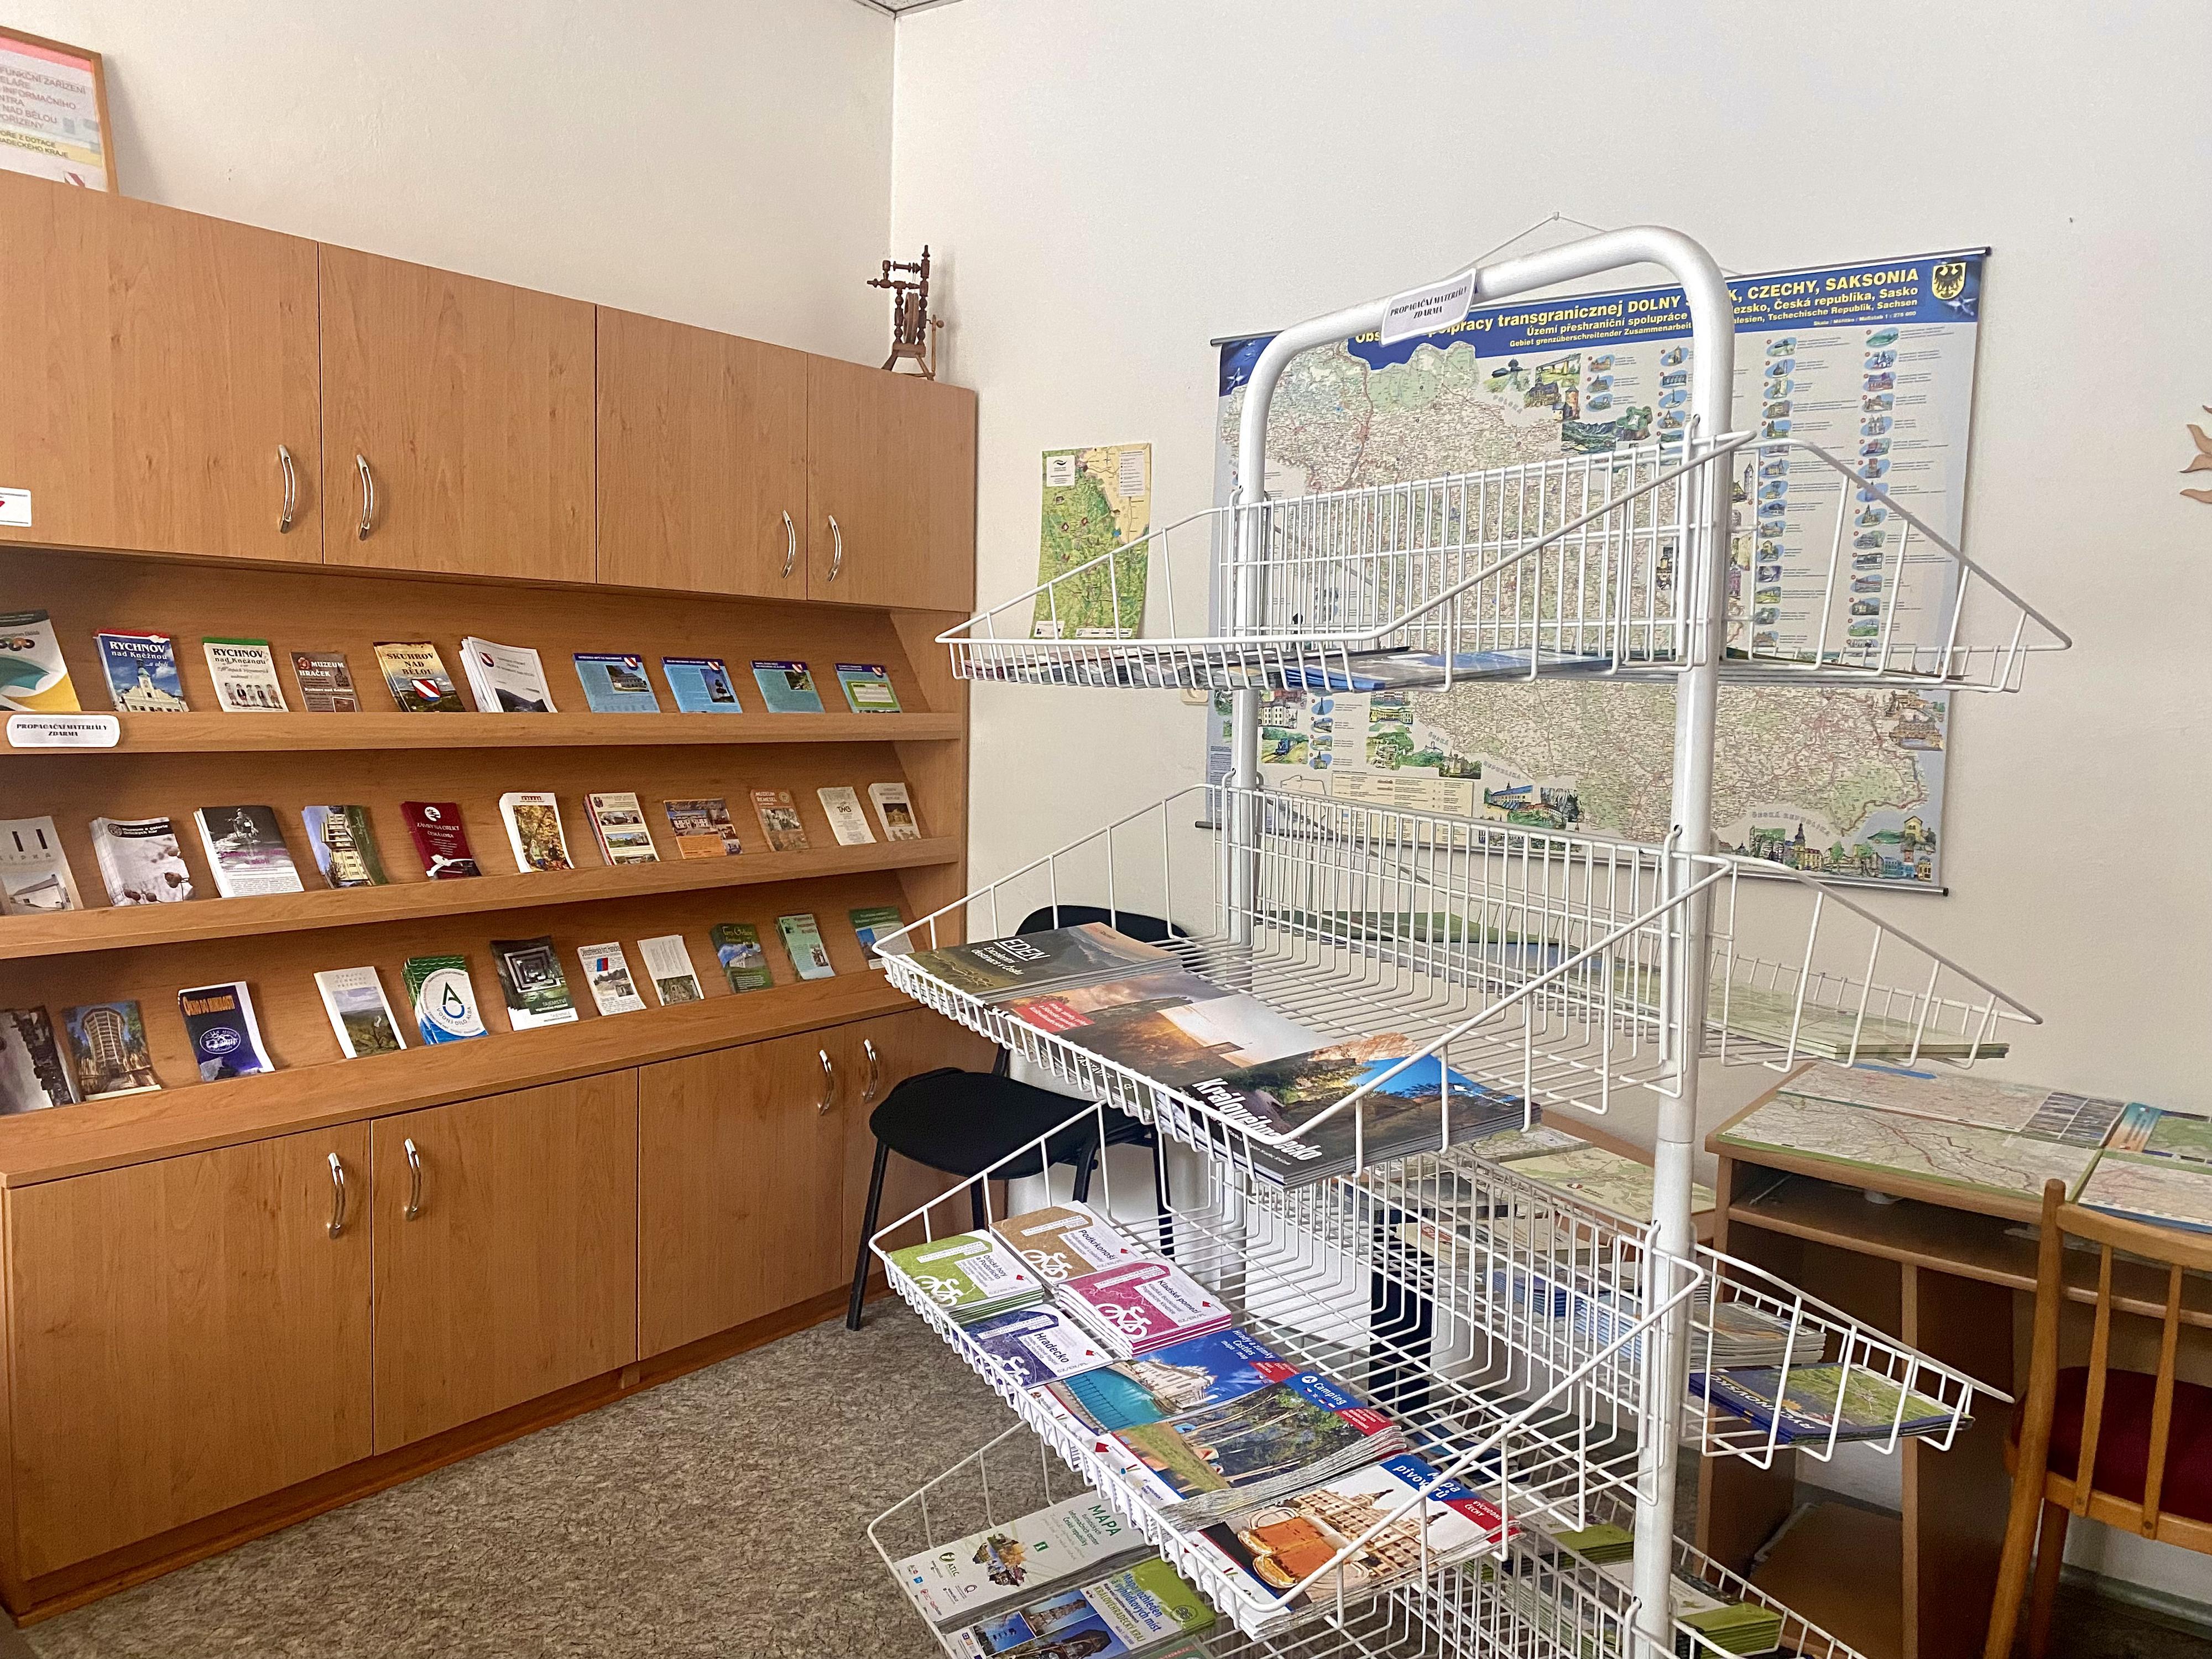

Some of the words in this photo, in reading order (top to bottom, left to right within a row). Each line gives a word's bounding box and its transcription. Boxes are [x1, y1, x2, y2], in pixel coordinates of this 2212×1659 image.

[3, 105, 23, 115] NAD
[25, 136, 56, 148] DOTACE
[45, 147, 69, 158] KRAJE
[1390, 296, 1433, 317] PROPAGAČNÍ
[1498, 300, 1624, 327] transgranicznej
[1627, 296, 1682, 314] DOLNY
[1747, 280, 1820, 300] CZECHY,
[1826, 269, 1919, 291] SAKSONIA
[1413, 306, 1442, 319] ZDARMA
[1527, 324, 1558, 337] Území
[1561, 317, 1625, 334] přeshraniční
[1628, 312, 1688, 327] spolupráce
[1773, 298, 1811, 311] Česká
[1814, 293, 1876, 308] republika,
[1879, 286, 1918, 299] Sasko
[1510, 338, 1534, 348] Gebiet
[1536, 330, 1623, 346] grenzüberschreitender
[1624, 321, 1692, 336] Zusammenarbeit
[1768, 308, 1828, 321] Tschechische
[1831, 302, 1874, 315] Republik,
[1877, 299, 1918, 310] Sachsen
[109, 641, 165, 653] RYCHNOV
[130, 651, 167, 660] Kněžnou
[212, 648, 263, 658] RYCHNOV
[299, 669, 331, 677] HRAČEK
[401, 667, 434, 675] BĚLOU
[999, 938, 1051, 960] EDEN
[1192, 1077, 1323, 1161] Královéhraecko
[1078, 1229, 1118, 1260] Podkrkonoší
[1158, 1280, 1182, 1299] Kladské
[1034, 1332, 1070, 1363] Hradecko
[1221, 1340, 1235, 1350] mapa
[1236, 1351, 1249, 1360] map
[1232, 1329, 1253, 1343] Hrady
[1253, 1344, 1276, 1359] zámky
[1232, 1340, 1256, 1355] Castles
[1313, 1383, 1347, 1406] Camping
[1392, 1465, 1448, 1499] pivovrů
[1427, 1472, 1460, 1493] Mpa
[1464, 1504, 1486, 1517] ČECHY
[1088, 1505, 1121, 1536] MAPA
[947, 1563, 959, 1577] ATIC
[1123, 1573, 1139, 1592] Mapa
[1093, 1586, 1137, 1632] KRÁLOVÉHRADECKÝ
[1129, 1626, 1146, 1642] KRAJ
[1144, 1617, 1162, 1632] míst
